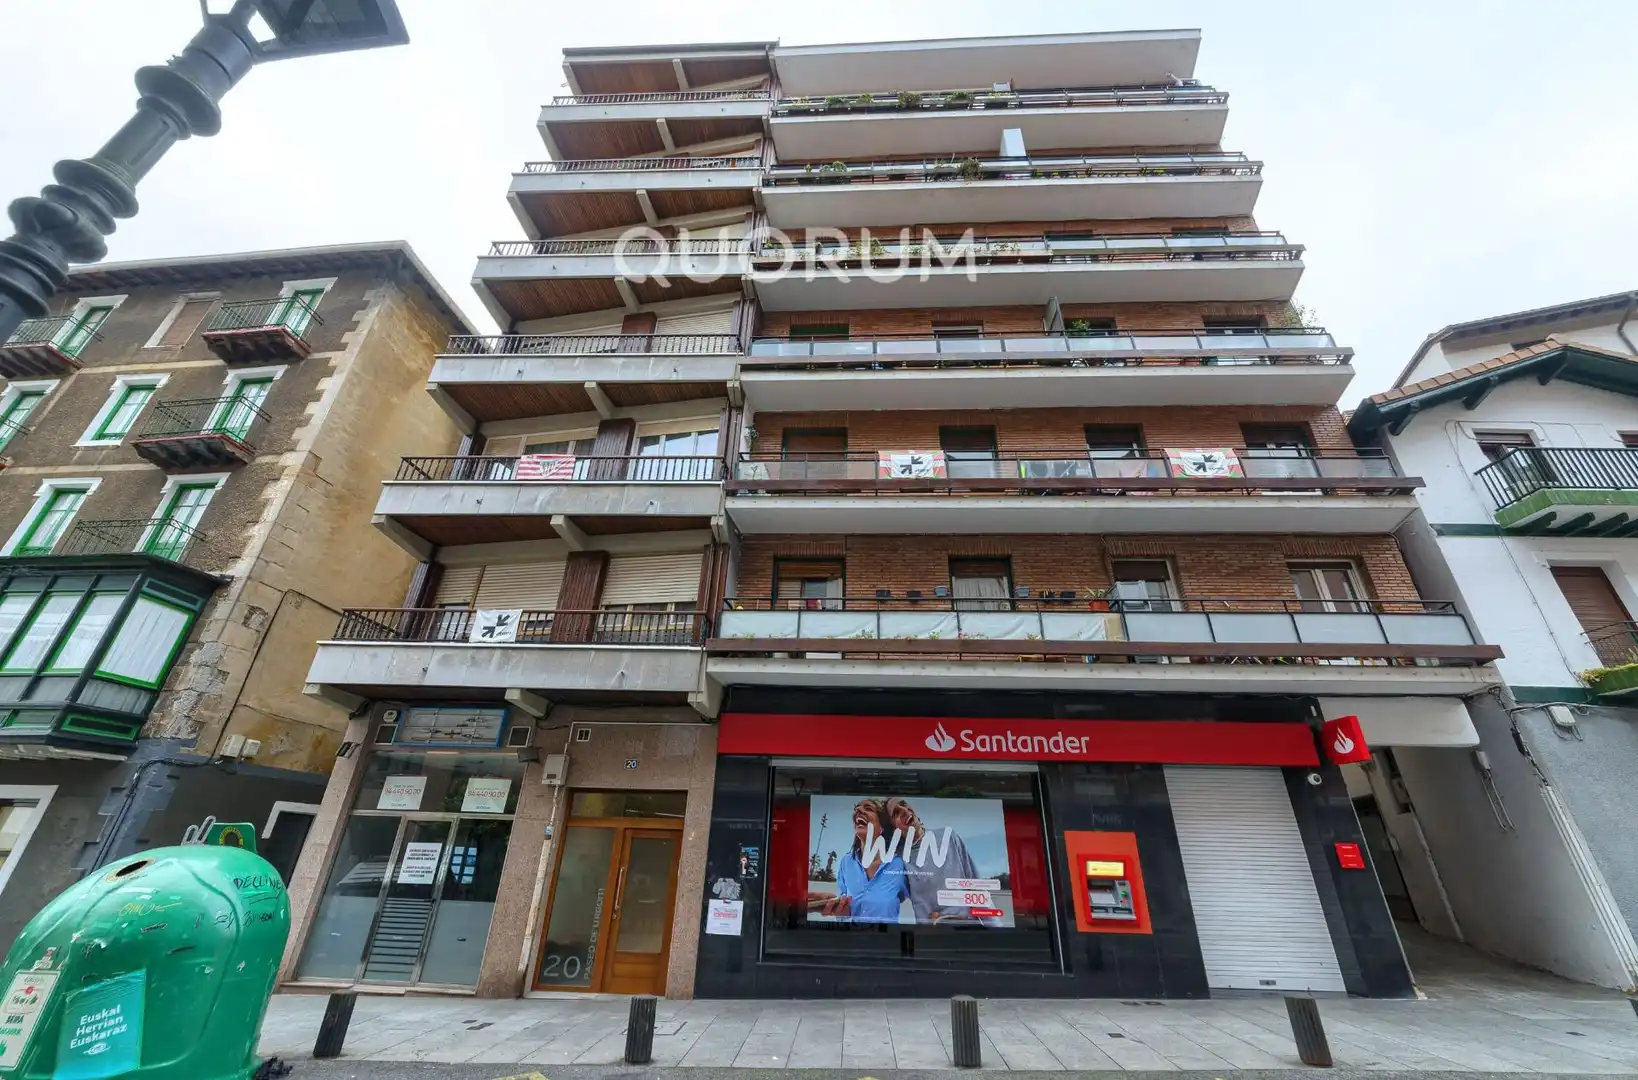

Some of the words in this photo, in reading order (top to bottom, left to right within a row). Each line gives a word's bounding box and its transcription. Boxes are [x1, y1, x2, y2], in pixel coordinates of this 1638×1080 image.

[959, 729, 1090, 753] Santander
[626, 760, 638, 769] 20
[862, 822, 952, 868] WIN
[543, 954, 581, 979] 20
[583, 945, 595, 980] PASEO
[590, 929, 598, 942] DE
[76, 1016, 124, 1037] Herrian
[80, 1004, 121, 1025] Euskal
[70, 1024, 128, 1049] Euskaraz
